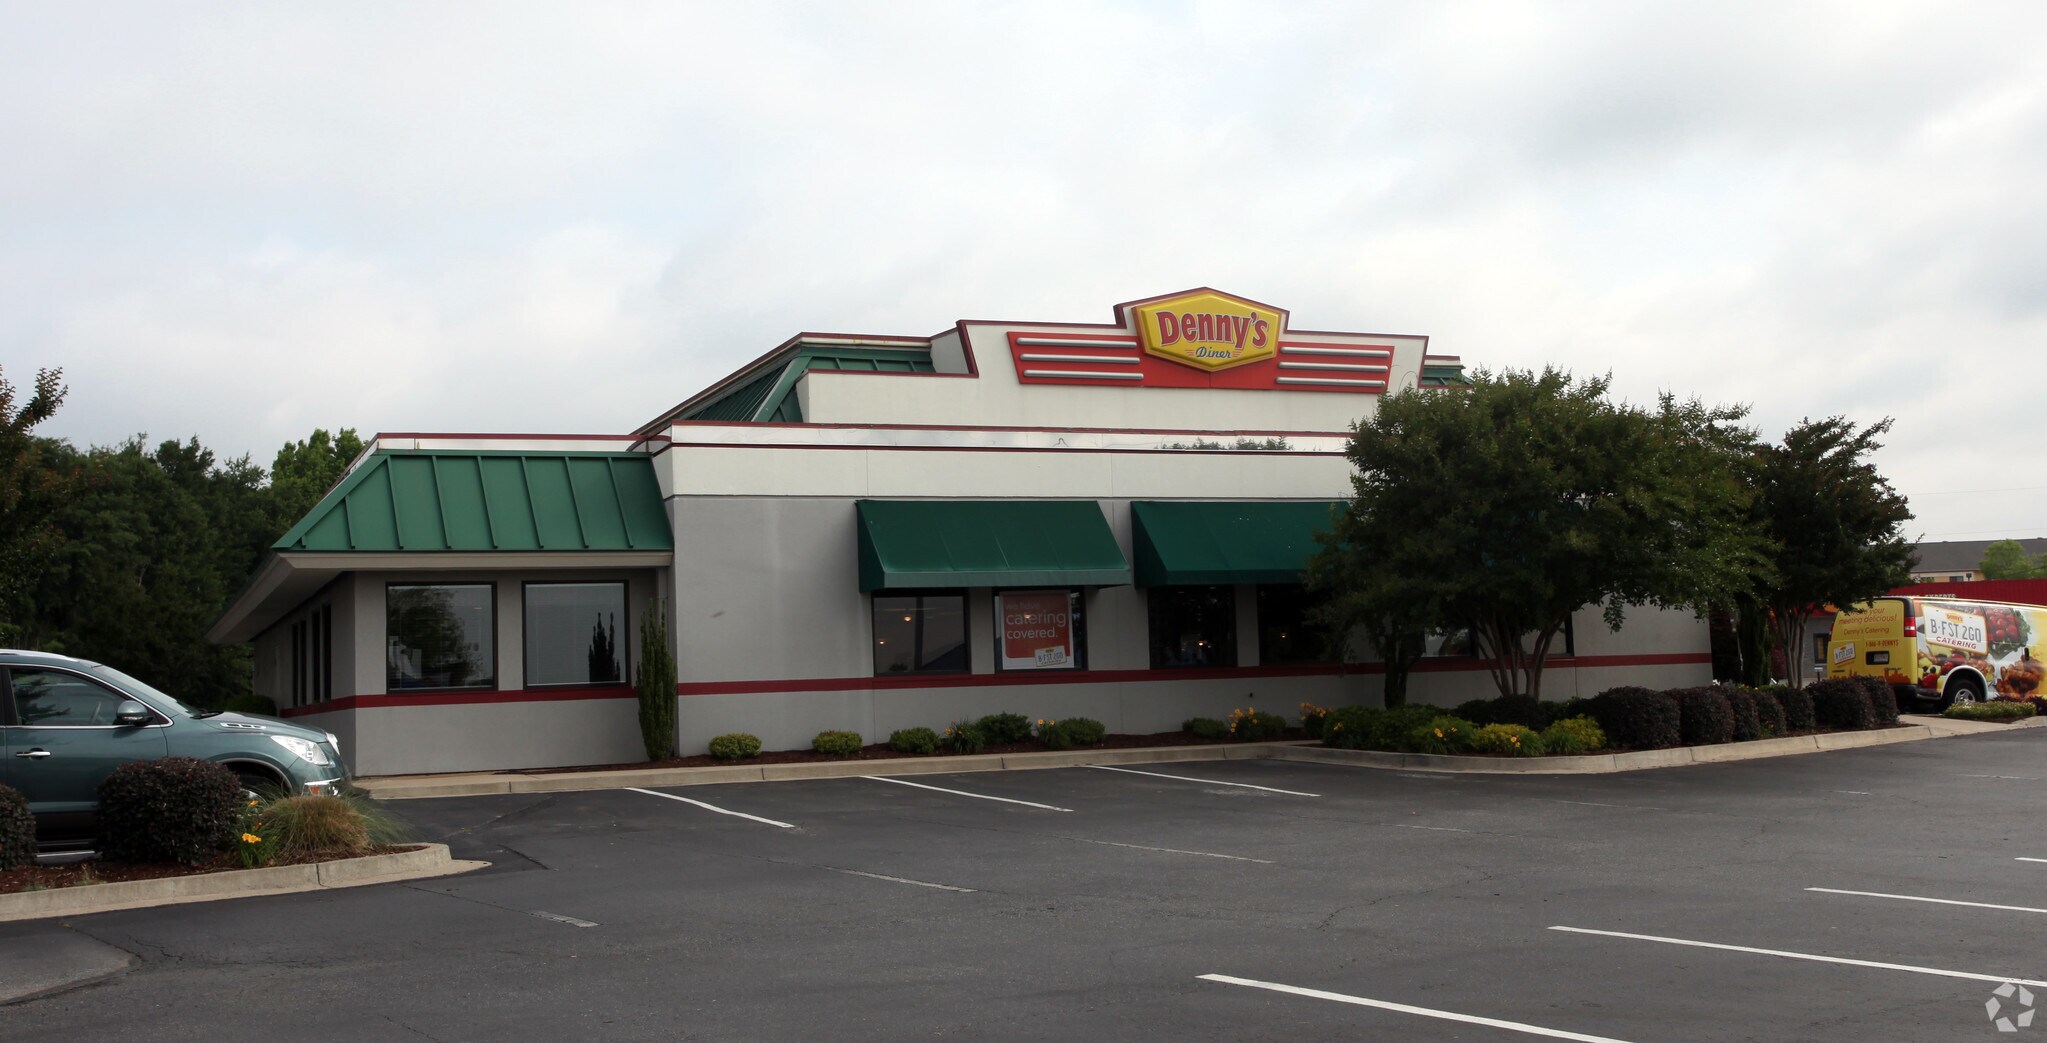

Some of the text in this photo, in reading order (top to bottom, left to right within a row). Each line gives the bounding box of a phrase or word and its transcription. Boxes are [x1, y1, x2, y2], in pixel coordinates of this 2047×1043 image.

[1155, 310, 1269, 350] Denny's
[1195, 346, 1231, 359] Diner
[1006, 609, 1067, 628] catering
[1869, 607, 1885, 617] your
[1838, 613, 1897, 626] meeting delicious!
[1006, 627, 1059, 640] covered.
[1843, 626, 1890, 636] Denny's Catering
[1962, 625, 1982, 643] 2GO
[1936, 636, 1977, 649] CATERING
